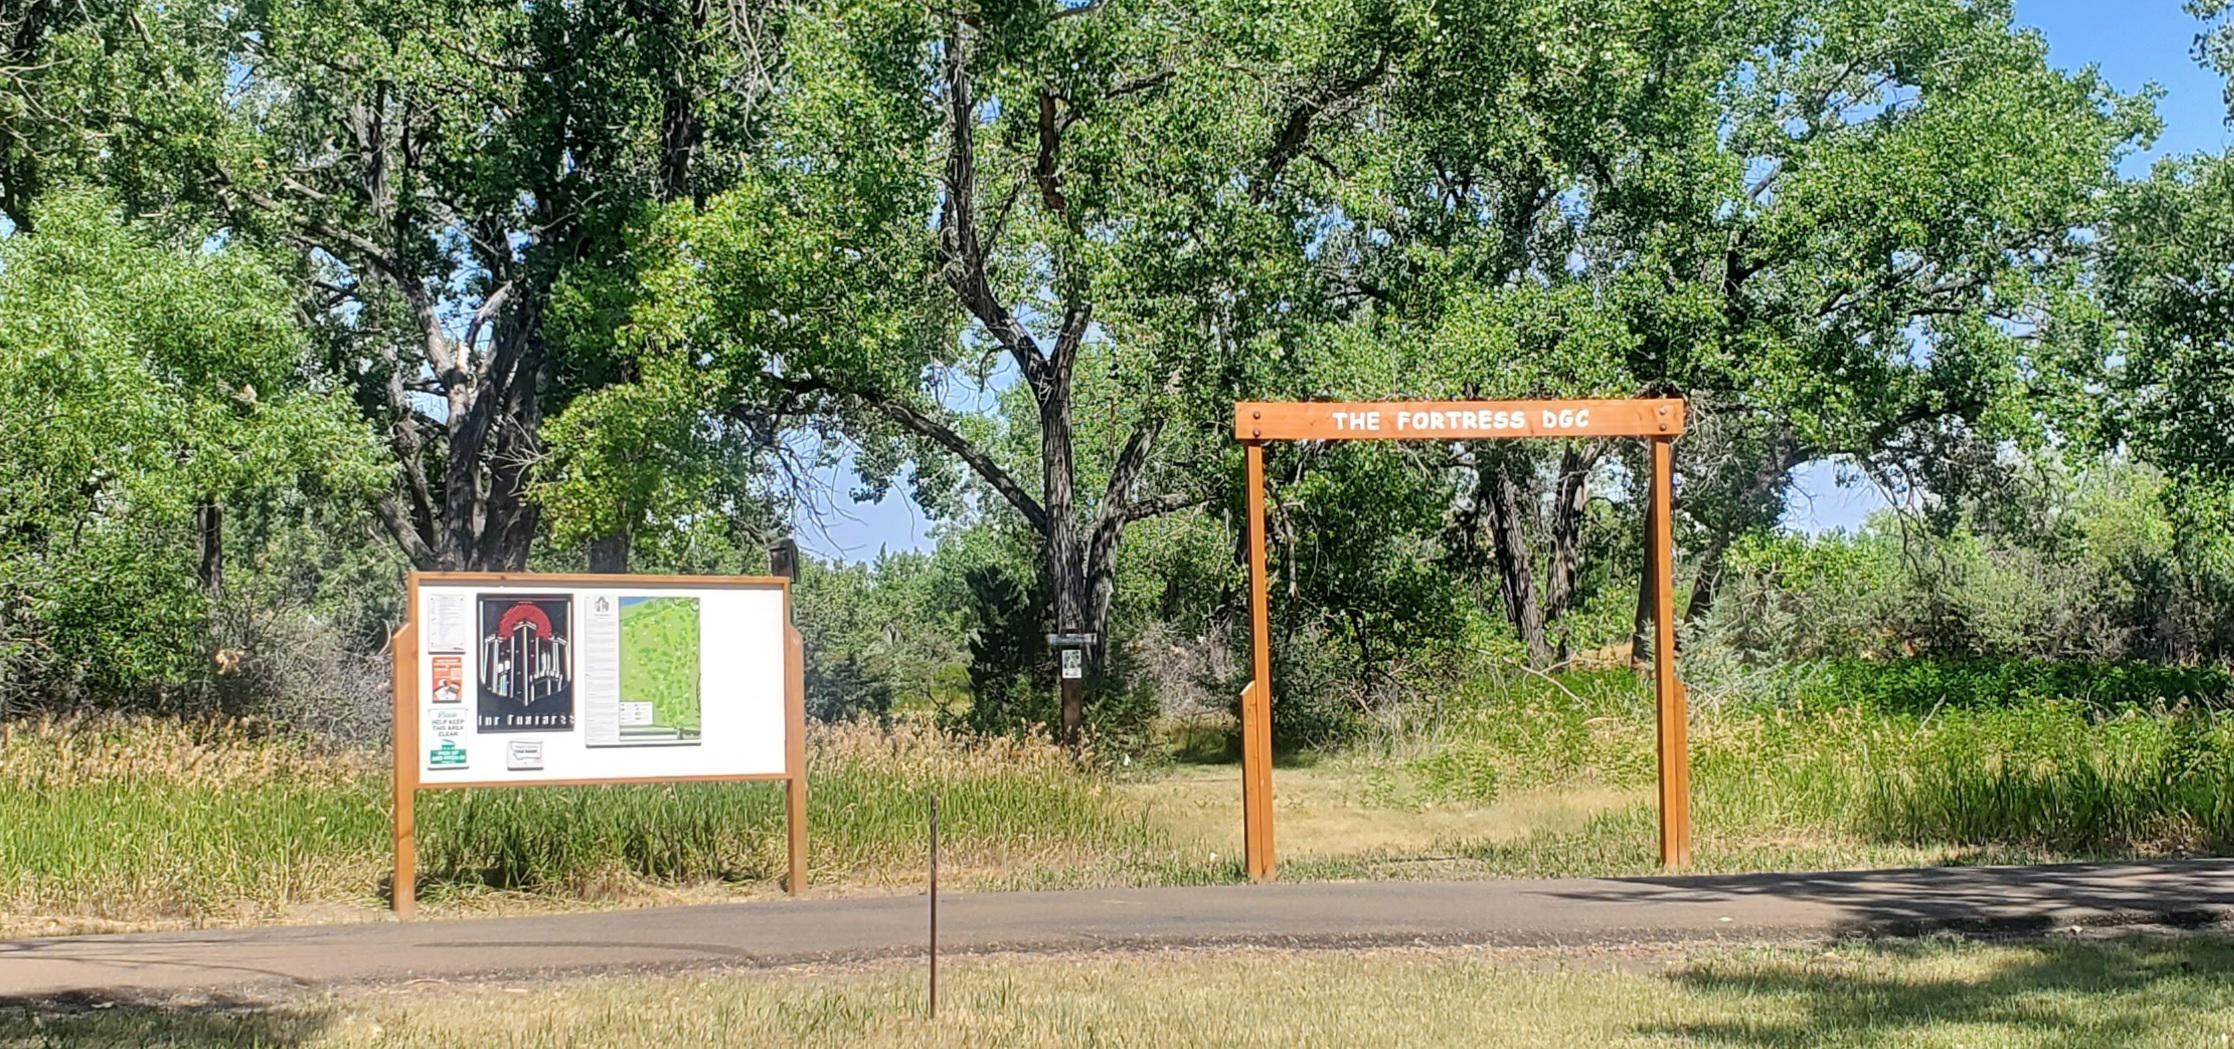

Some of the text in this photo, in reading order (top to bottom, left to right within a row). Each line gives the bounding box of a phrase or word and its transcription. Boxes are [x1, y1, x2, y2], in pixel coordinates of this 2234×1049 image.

[1332, 408, 1590, 431] THE FORTRESS DGC
